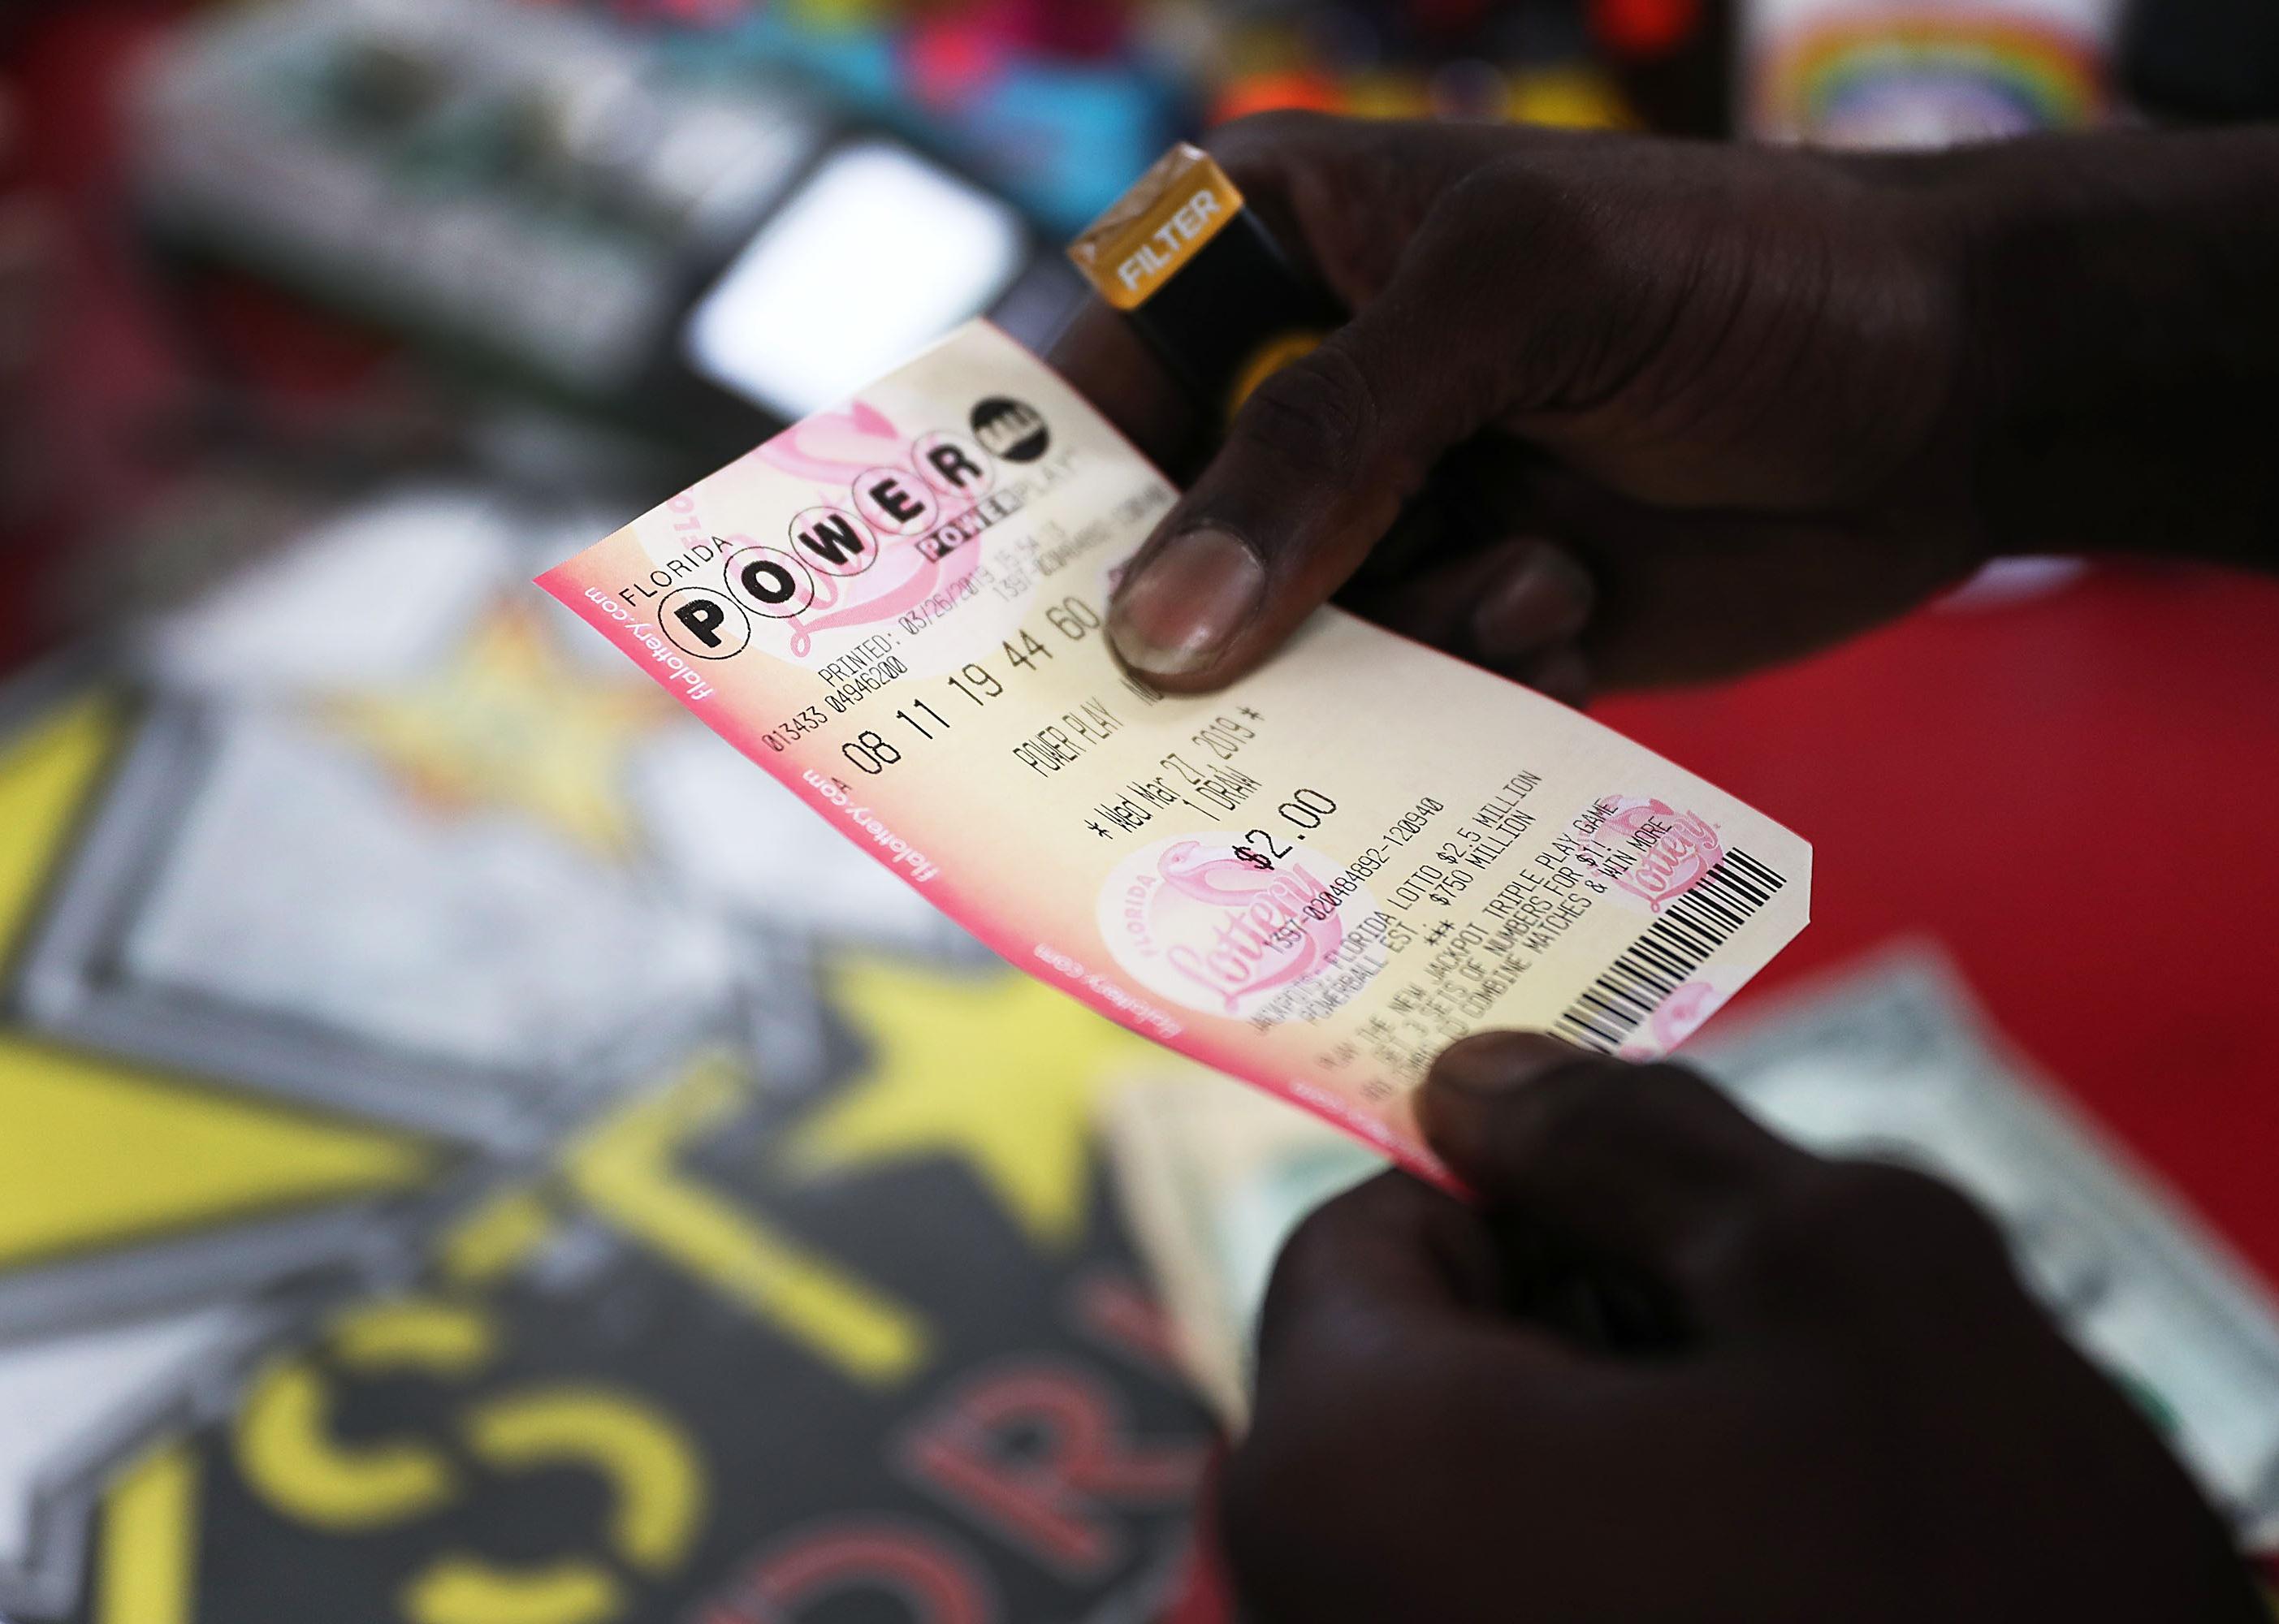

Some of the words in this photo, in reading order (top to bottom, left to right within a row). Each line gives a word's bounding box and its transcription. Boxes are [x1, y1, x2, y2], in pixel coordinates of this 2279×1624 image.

[1118, 191, 1221, 289] FILTER
[617, 536, 733, 612] FLORIDA
[672, 444, 982, 648] POWER
[583, 585, 714, 703] flalottery.com
[816, 632, 901, 691] PRINTED:
[839, 728, 902, 775] 08
[896, 698, 950, 740] 11
[947, 663, 1003, 706] 19
[1002, 628, 1053, 671] 44
[1045, 596, 1101, 641] 60
[761, 702, 832, 757] 013433
[822, 652, 908, 715] 04946200
[1012, 726, 1087, 780] POWER
[1062, 697, 1123, 746] PLAY
[802, 769, 938, 884] flalottery.com
[1096, 793, 1152, 836] Wed
[1127, 773, 1183, 812] Mar
[1191, 716, 1256, 760] 2019
[1180, 796, 1221, 823] 1
[1194, 763, 1262, 812] DRAW
[1232, 788, 1337, 871] $2.00
[1124, 874, 1158, 957] FLORIDA
[1324, 907, 1395, 970] FLORIDA
[1385, 864, 1446, 910] LOTTO
[1435, 824, 1485, 869] $2.5
[1472, 770, 1542, 831] MILLION
[1380, 914, 1427, 953] EST.
[1425, 866, 1475, 909] $750
[1464, 806, 1536, 871] MILLION
[1421, 920, 1491, 983] JACKPOT
[1481, 869, 1545, 924] TRIPLE
[1535, 832, 1583, 875] PLAY
[1572, 798, 1619, 839] GAME
[1457, 957, 1489, 984] OF
[1483, 893, 1554, 958] NUMBERS
[1545, 865, 1585, 899] FOR
[1574, 836, 1613, 870] $1!
[1462, 956, 1533, 1019] COMBINE
[1523, 892, 1592, 954] MATCHES
[1587, 876, 1609, 896] &
[1599, 849, 1638, 883] WIN
[1628, 814, 1675, 855] MORE
[1616, 809, 1720, 913] Lottery
[1168, 862, 1332, 1013] Lottery
